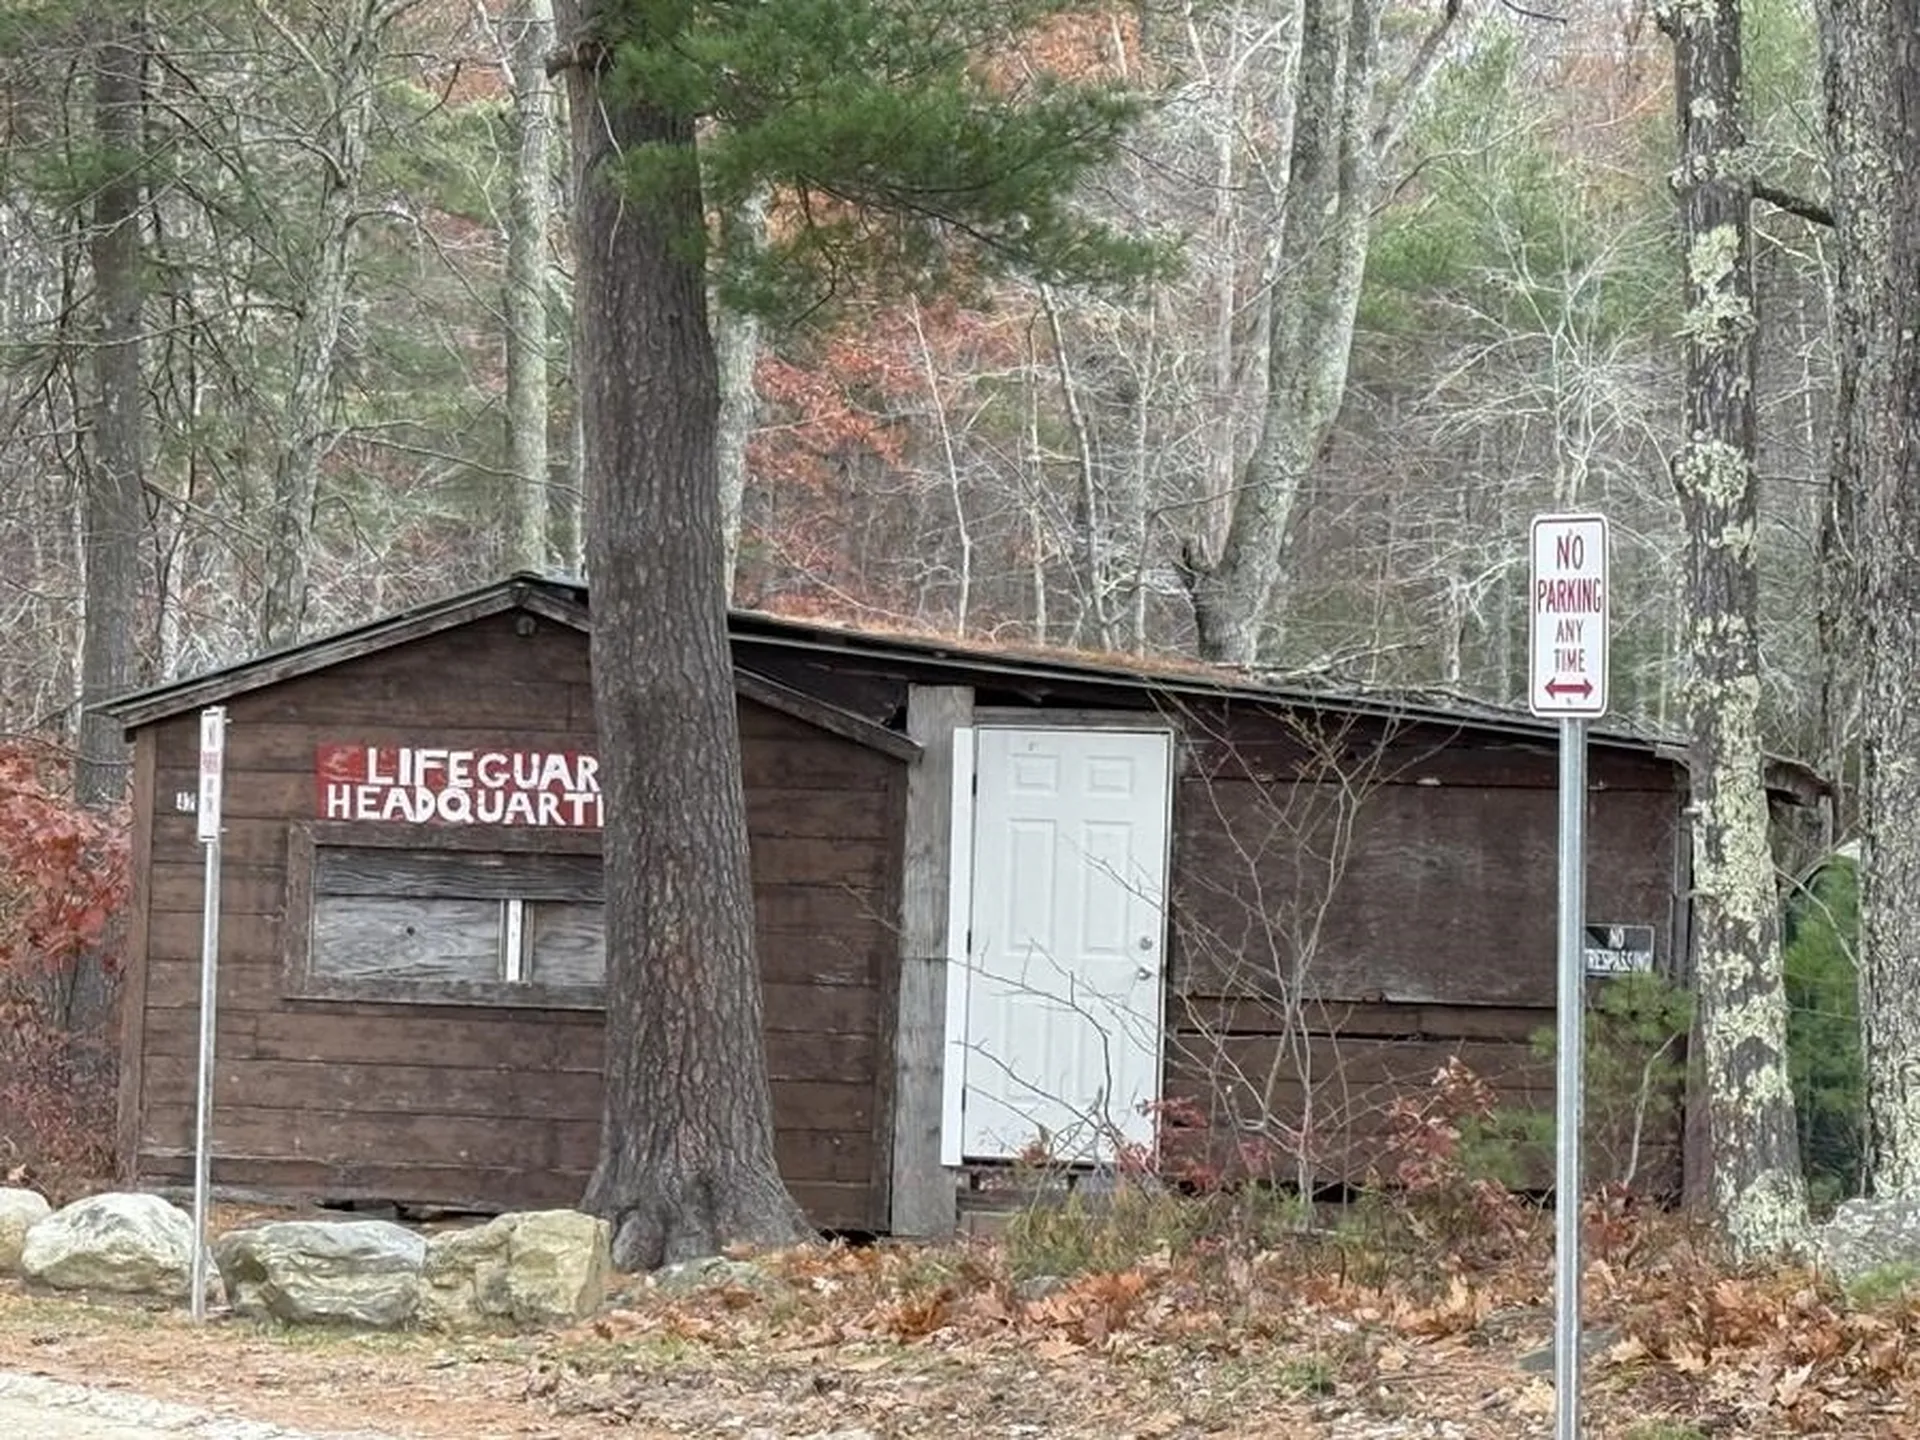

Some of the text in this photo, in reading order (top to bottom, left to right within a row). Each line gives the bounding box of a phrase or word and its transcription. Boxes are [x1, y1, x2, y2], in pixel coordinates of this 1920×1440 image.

[1556, 535, 1584, 570] NO
[1538, 577, 1601, 614] PARKING
[1555, 619, 1584, 644] ANY
[1554, 648, 1585, 673] TIME
[367, 748, 600, 792] LIFEGUAR
